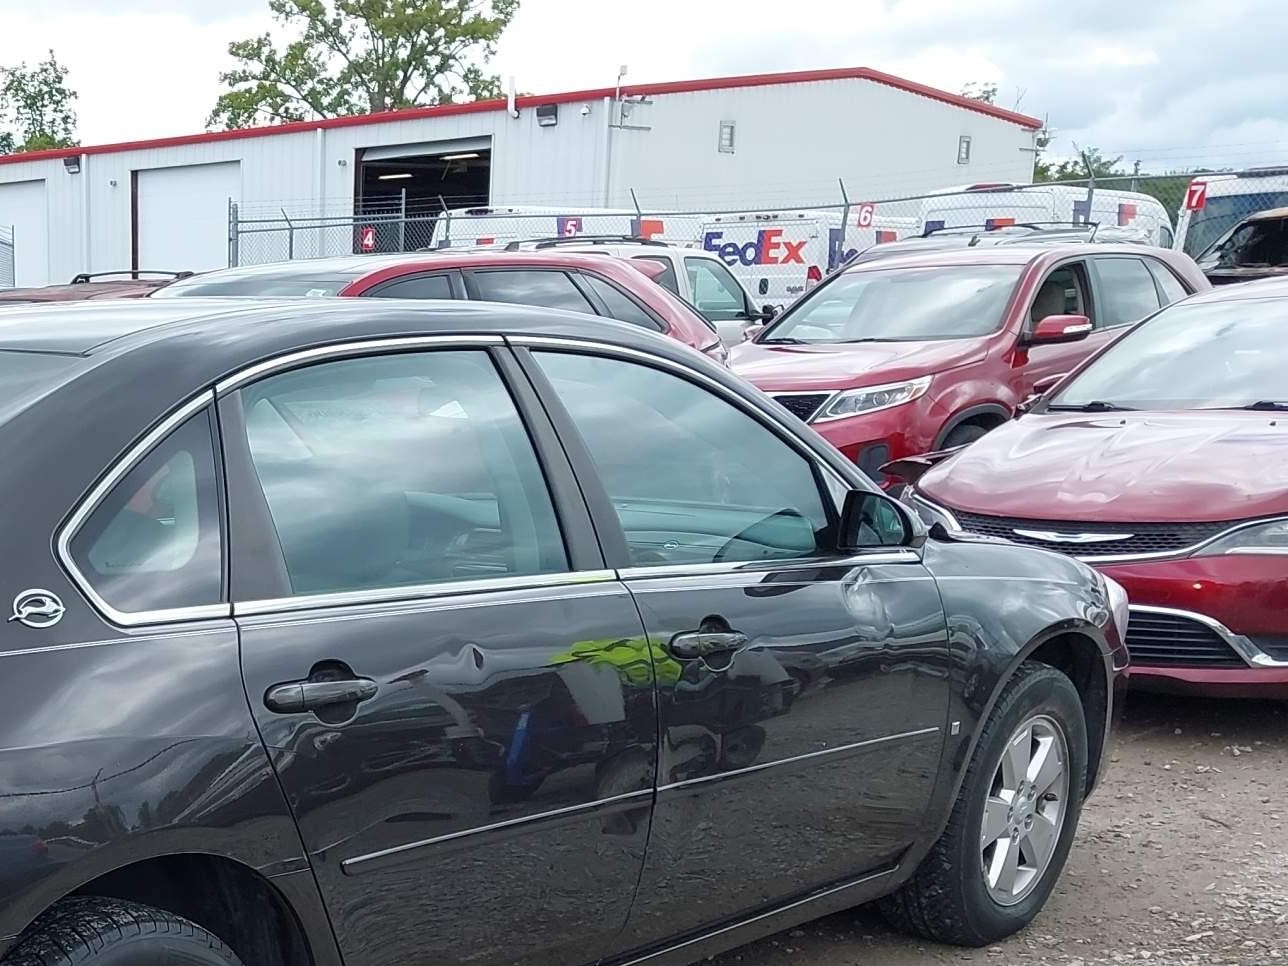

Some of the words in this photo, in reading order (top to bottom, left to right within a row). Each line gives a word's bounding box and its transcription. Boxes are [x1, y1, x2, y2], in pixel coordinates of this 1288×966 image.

[1190, 185, 1205, 207] 7
[860, 206, 872, 226] 6
[565, 221, 577, 237] 5
[364, 231, 374, 248] 4
[704, 230, 807, 266] FedEx
